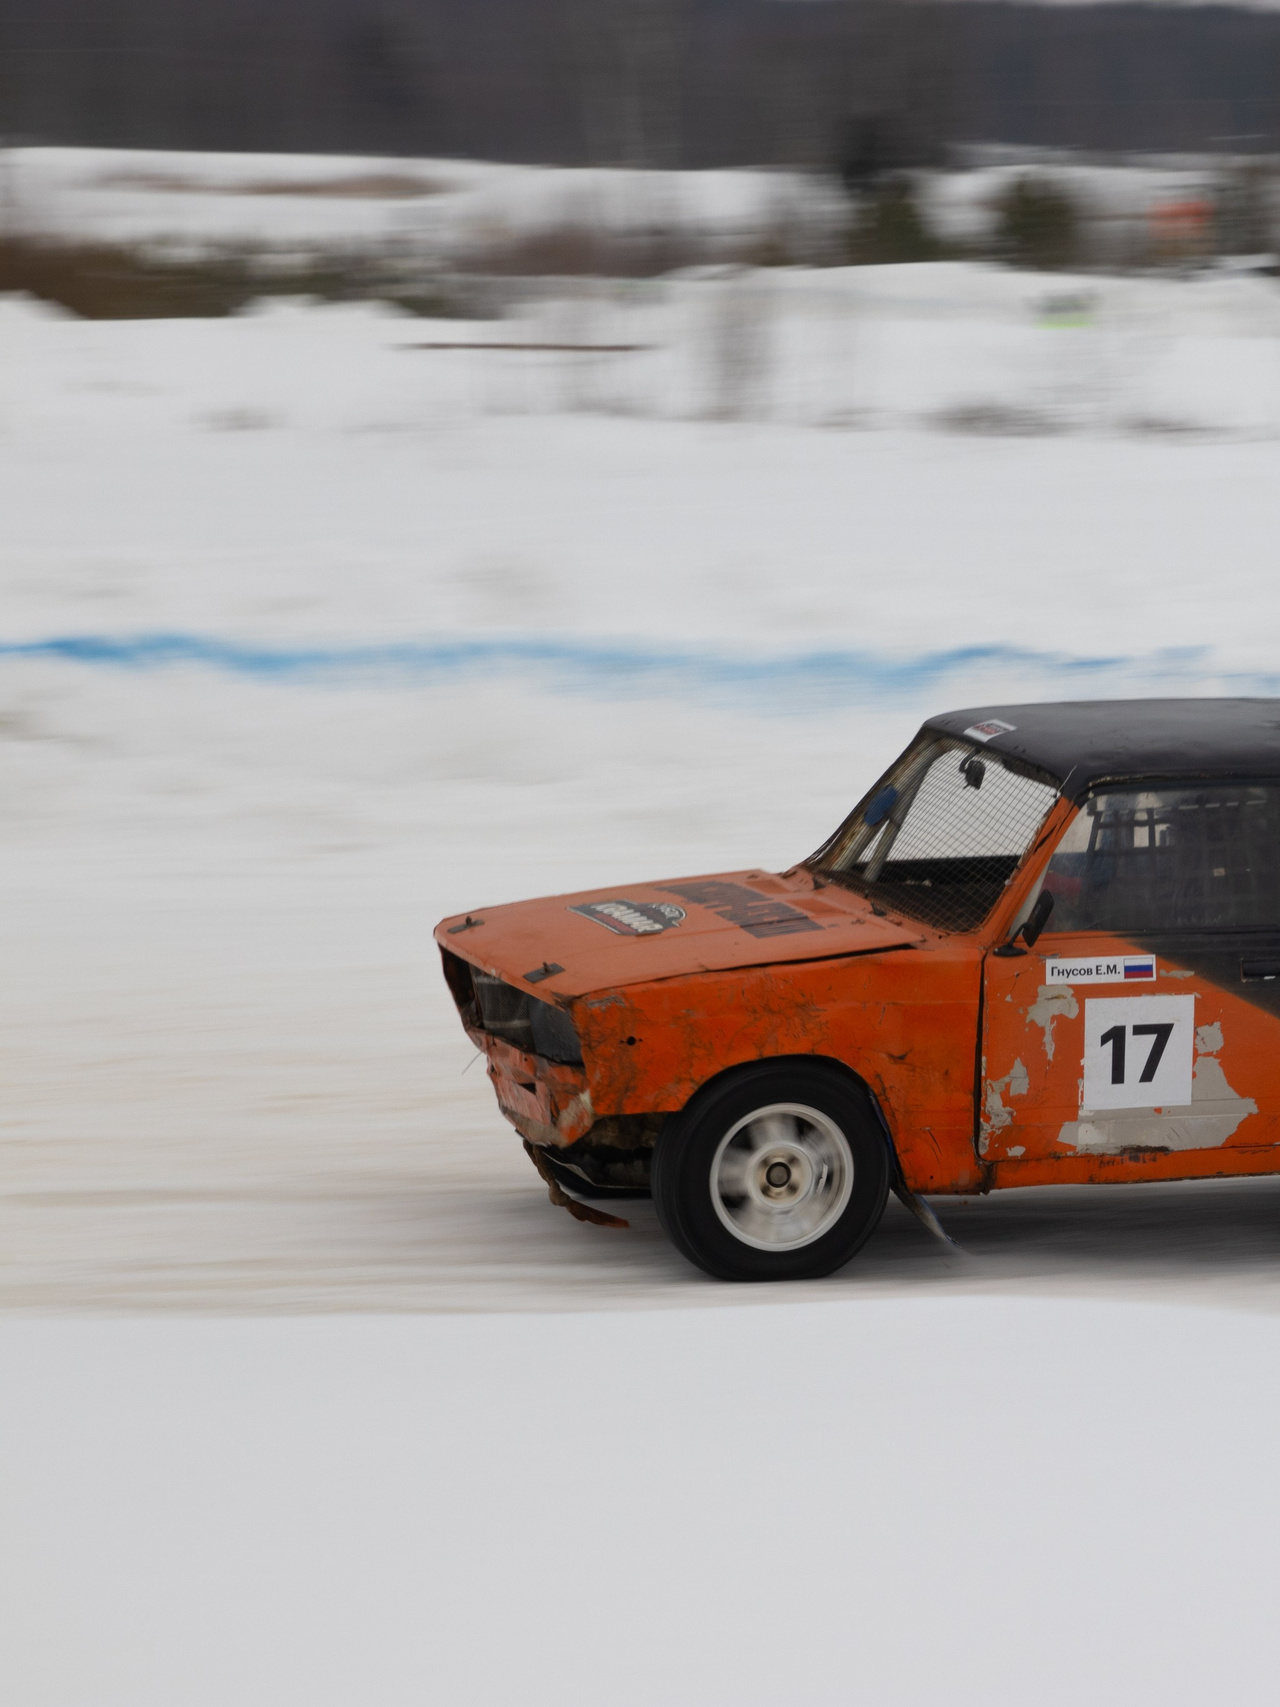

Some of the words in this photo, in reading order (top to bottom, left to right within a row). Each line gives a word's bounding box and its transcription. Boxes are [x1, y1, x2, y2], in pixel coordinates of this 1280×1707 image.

[1051, 966, 1093, 978] Гнусов
[1096, 964, 1121, 976] Е.М.
[1100, 1023, 1175, 1085] 17
